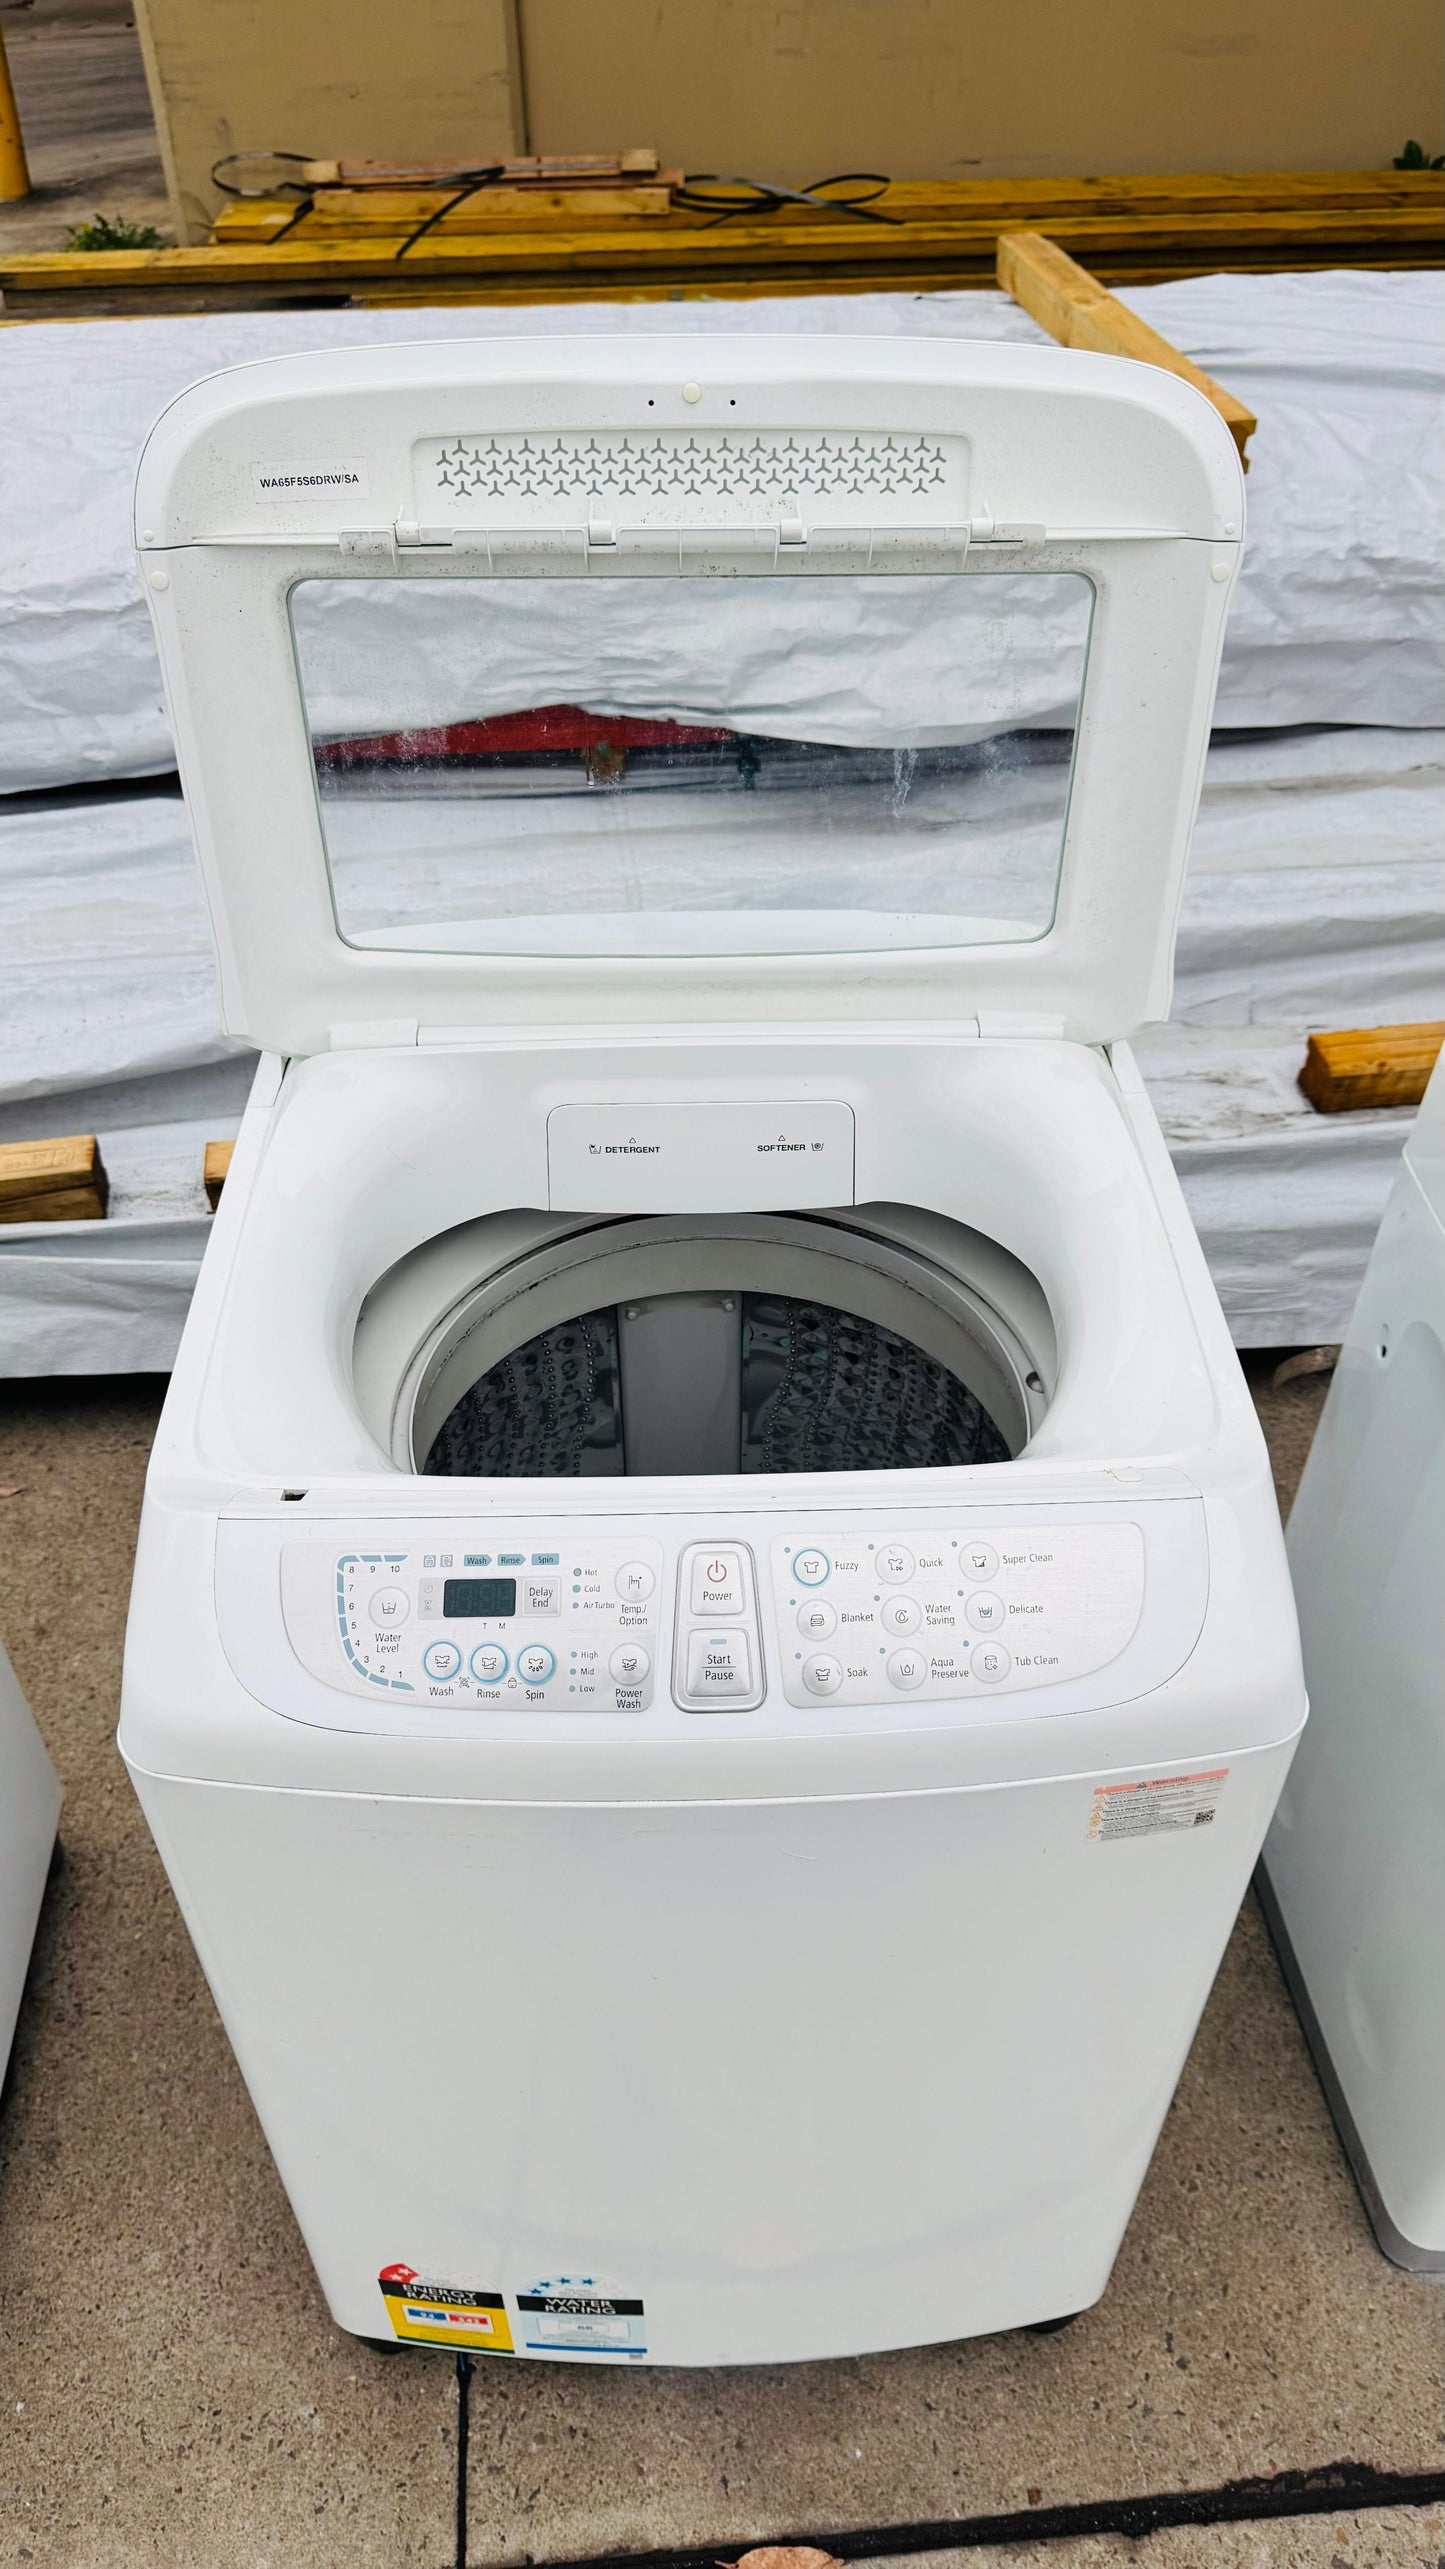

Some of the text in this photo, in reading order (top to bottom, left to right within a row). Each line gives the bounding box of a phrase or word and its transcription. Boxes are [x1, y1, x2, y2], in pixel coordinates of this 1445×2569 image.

[260, 473, 359, 488] WA65F5S6DRW/SA
[605, 1146, 660, 1154] DETERGENT
[757, 1143, 806, 1152] SOFTENER
[466, 1557, 487, 1565] Wash
[501, 1556, 520, 1564] Rinse
[538, 1556, 554, 1565] Spin
[919, 1558, 943, 1568] Quick
[1002, 1553, 1053, 1565] Super Clean
[349, 1566, 355, 1574] 8
[390, 1565, 400, 1573] 10
[835, 1561, 859, 1571] Fuzzy
[349, 1584, 354, 1592] 7
[529, 1587, 553, 1598] Delay
[584, 1585, 601, 1593] Cold
[703, 1591, 732, 1601] Power
[349, 1603, 355, 1611] 6
[532, 1598, 549, 1608] End
[621, 1604, 647, 1614] Temp./
[925, 1604, 951, 1613] Water
[1009, 1604, 1044, 1614] Delicate
[619, 1616, 648, 1626] Option
[841, 1613, 874, 1623] Blanket
[926, 1615, 955, 1626] Saving
[351, 1622, 357, 1630] 5
[375, 1633, 402, 1643] Water
[376, 1644, 399, 1653] Level
[364, 1656, 370, 1664] 3
[581, 1651, 599, 1660] High
[707, 1654, 731, 1664] Start
[1015, 1655, 1059, 1666] Tub Clean
[931, 1657, 954, 1669] Aqua
[398, 1671, 403, 1679] 1
[581, 1668, 595, 1676] Mid
[705, 1671, 734, 1681] Pause
[847, 1667, 869, 1677] Soak
[931, 1669, 969, 1679] Preserve
[429, 1687, 454, 1696] Wash
[477, 1689, 500, 1698] Rinse
[580, 1685, 595, 1693] Low
[615, 1689, 643, 1698] Power
[526, 1690, 545, 1701] Spin
[616, 1699, 641, 1709] Wash
[403, 2284, 477, 2299] ENERGY
[406, 2292, 477, 2306] RATING
[546, 2299, 613, 2308] WATER
[544, 2305, 616, 2315] RATING
